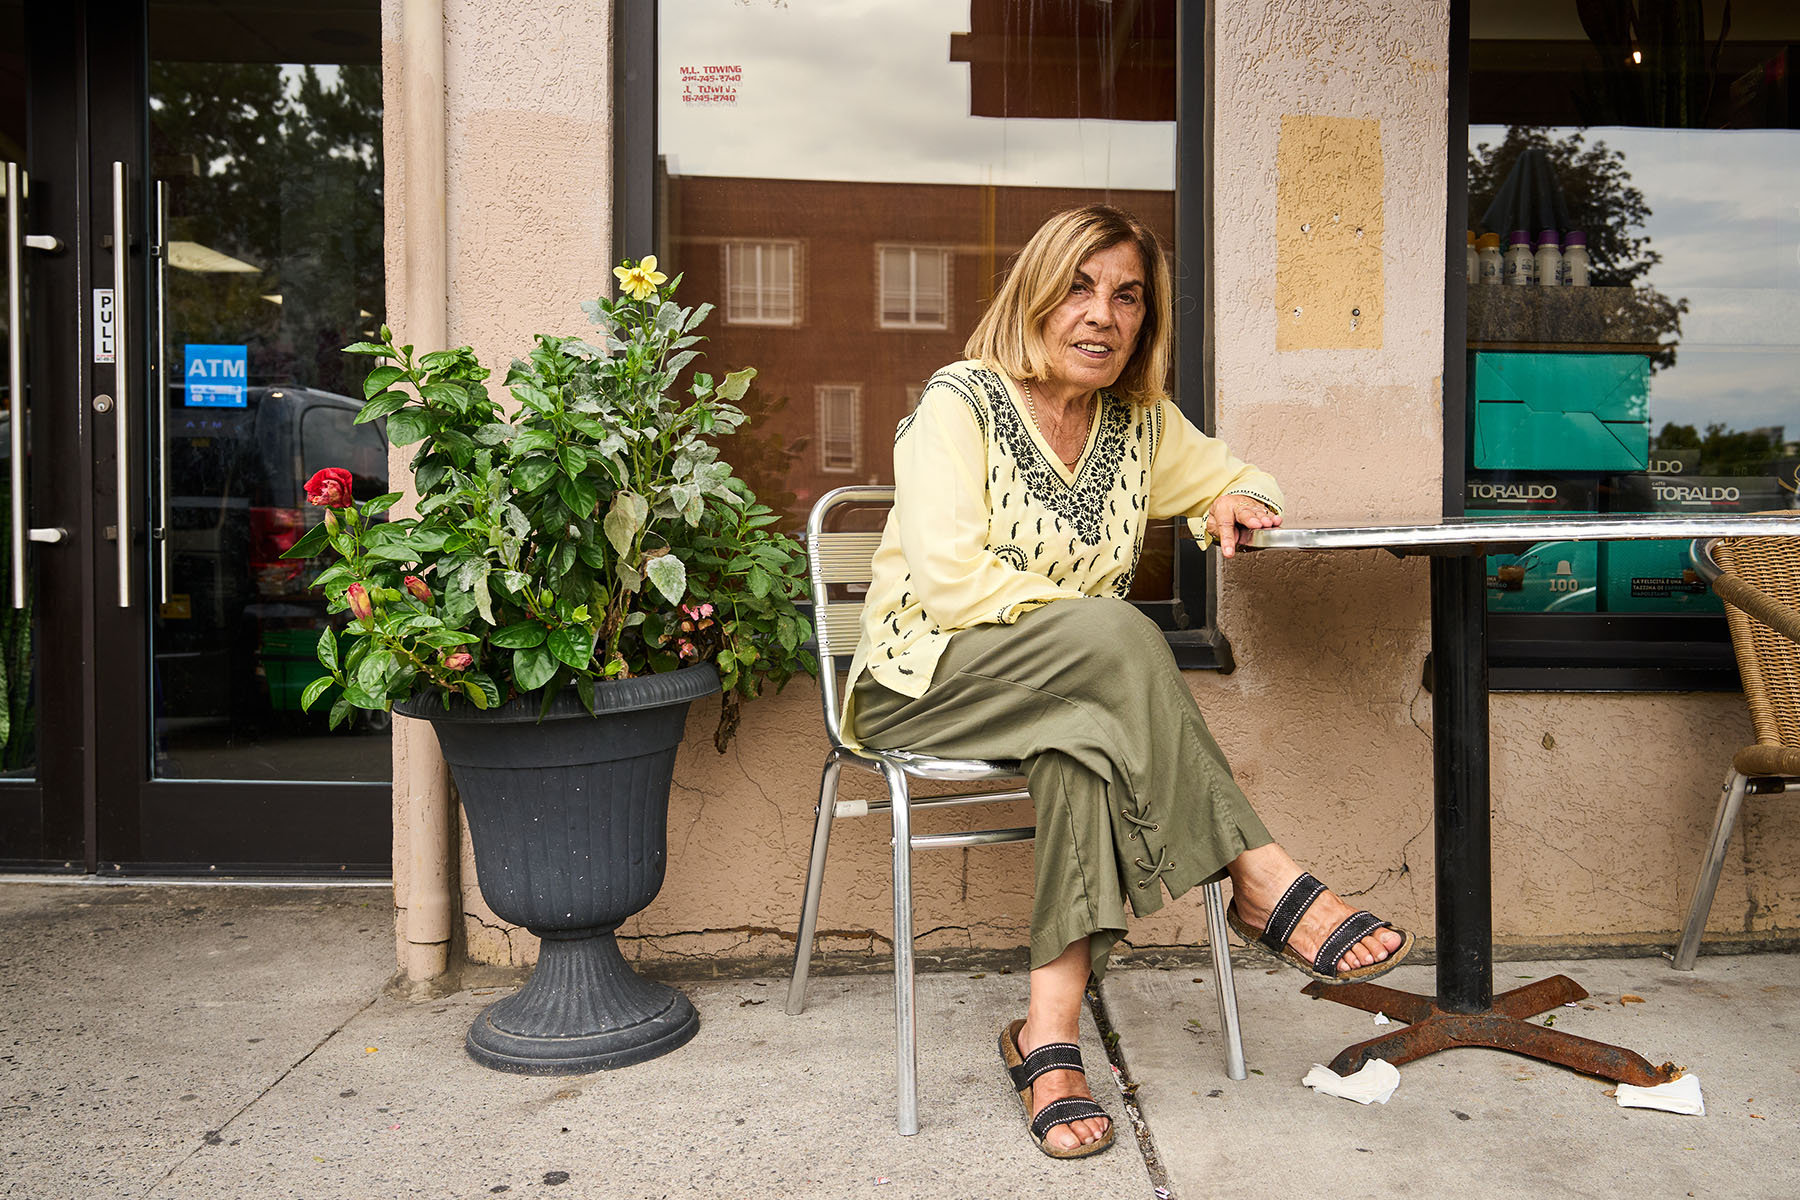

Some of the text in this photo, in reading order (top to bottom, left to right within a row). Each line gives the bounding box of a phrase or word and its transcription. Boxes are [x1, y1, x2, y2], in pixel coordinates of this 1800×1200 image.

[680, 65, 742, 74] M.L. TOWING
[101, 296, 112, 353] PULL
[188, 359, 245, 378] ATM
[1647, 460, 1683, 474] LDO
[1467, 484, 1557, 499] TORALDO
[1651, 486, 1740, 501] TORALDO
[1549, 578, 1578, 592] 100
